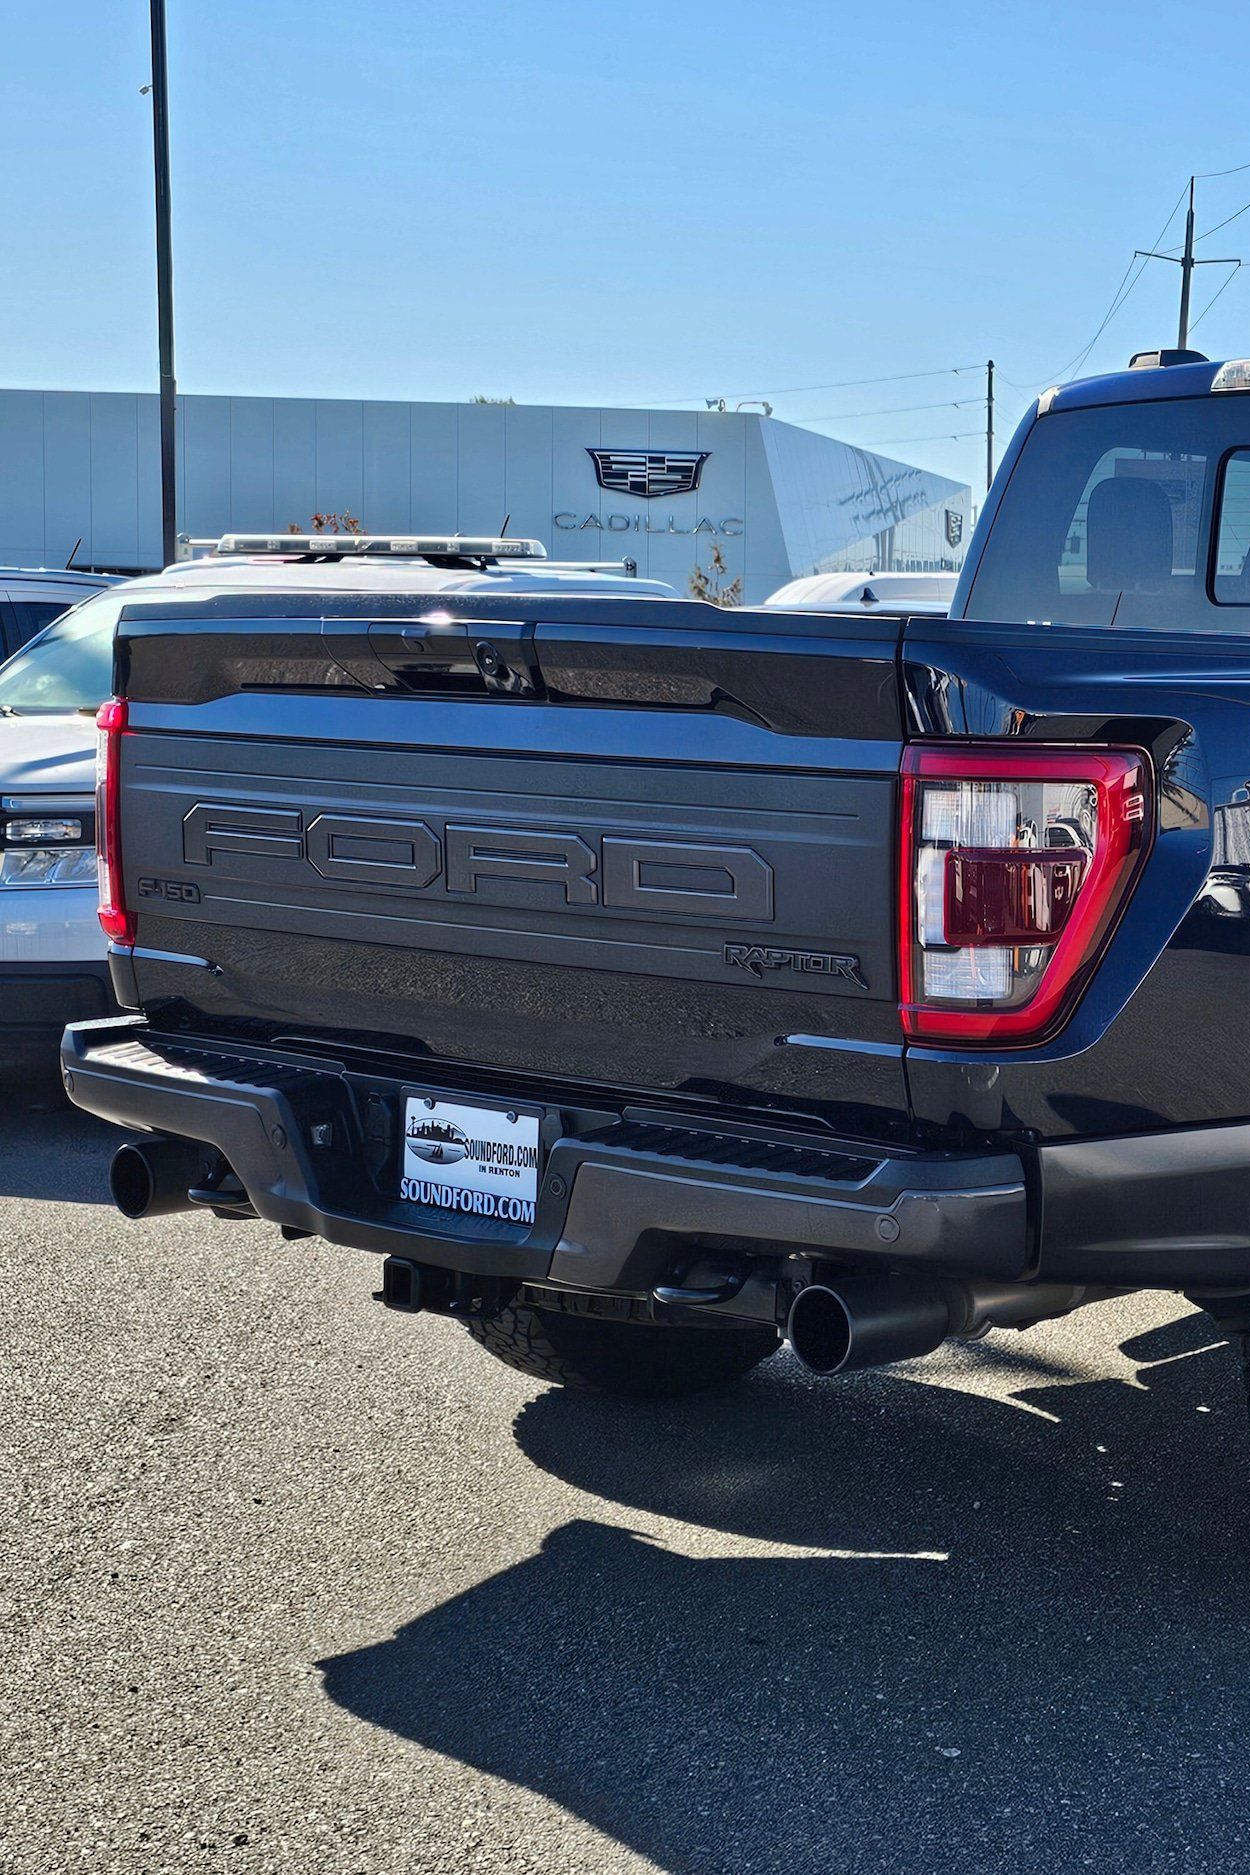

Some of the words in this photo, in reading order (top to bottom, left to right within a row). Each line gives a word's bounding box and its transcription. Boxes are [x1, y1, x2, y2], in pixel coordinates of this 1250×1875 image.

[553, 512, 744, 536] CADILLAC
[183, 802, 775, 922] FORD
[138, 877, 200, 904] F-150
[723, 942, 870, 990] RAPTOR
[464, 1138, 538, 1168] SOUNDFORD.COM
[478, 1164, 487, 1174] IN
[488, 1166, 521, 1178] RENTON
[400, 1177, 535, 1224] SOUNDFORD.COM
